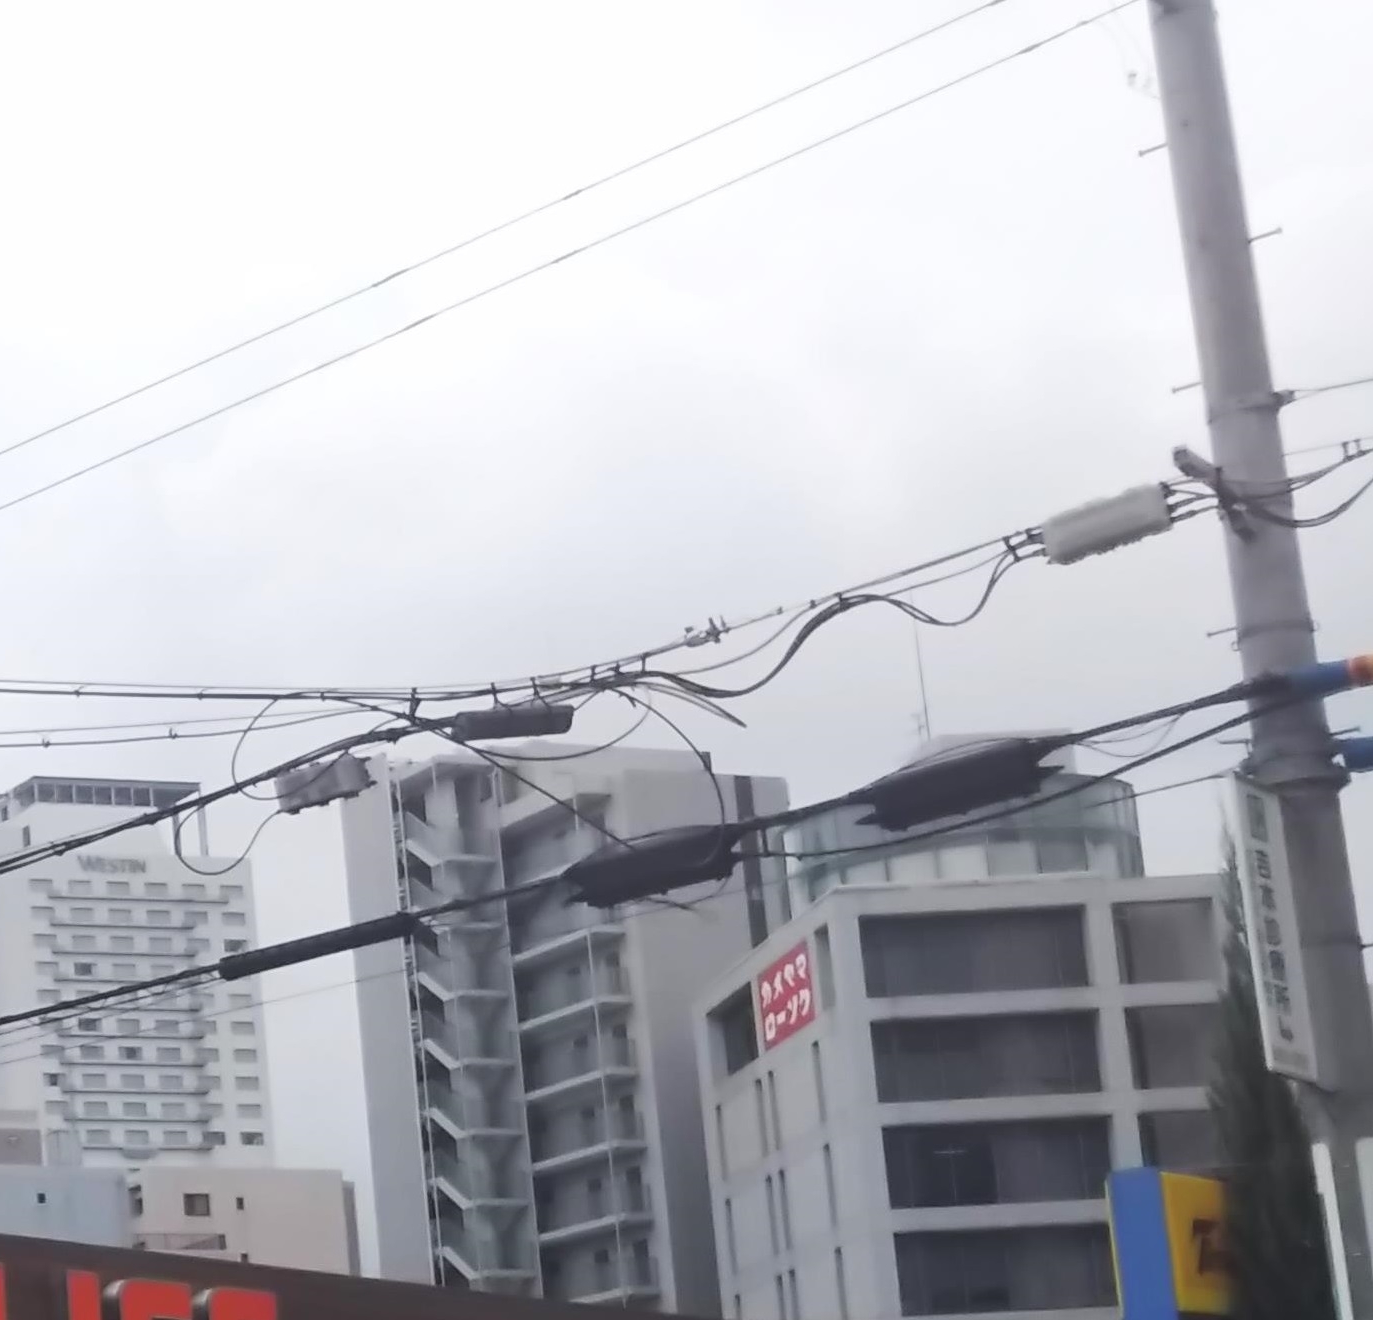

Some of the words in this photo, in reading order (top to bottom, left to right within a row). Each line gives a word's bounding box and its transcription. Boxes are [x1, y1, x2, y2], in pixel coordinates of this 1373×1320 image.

[760, 953, 807, 1008] カメヤマ
[765, 988, 811, 1041] ローソク
